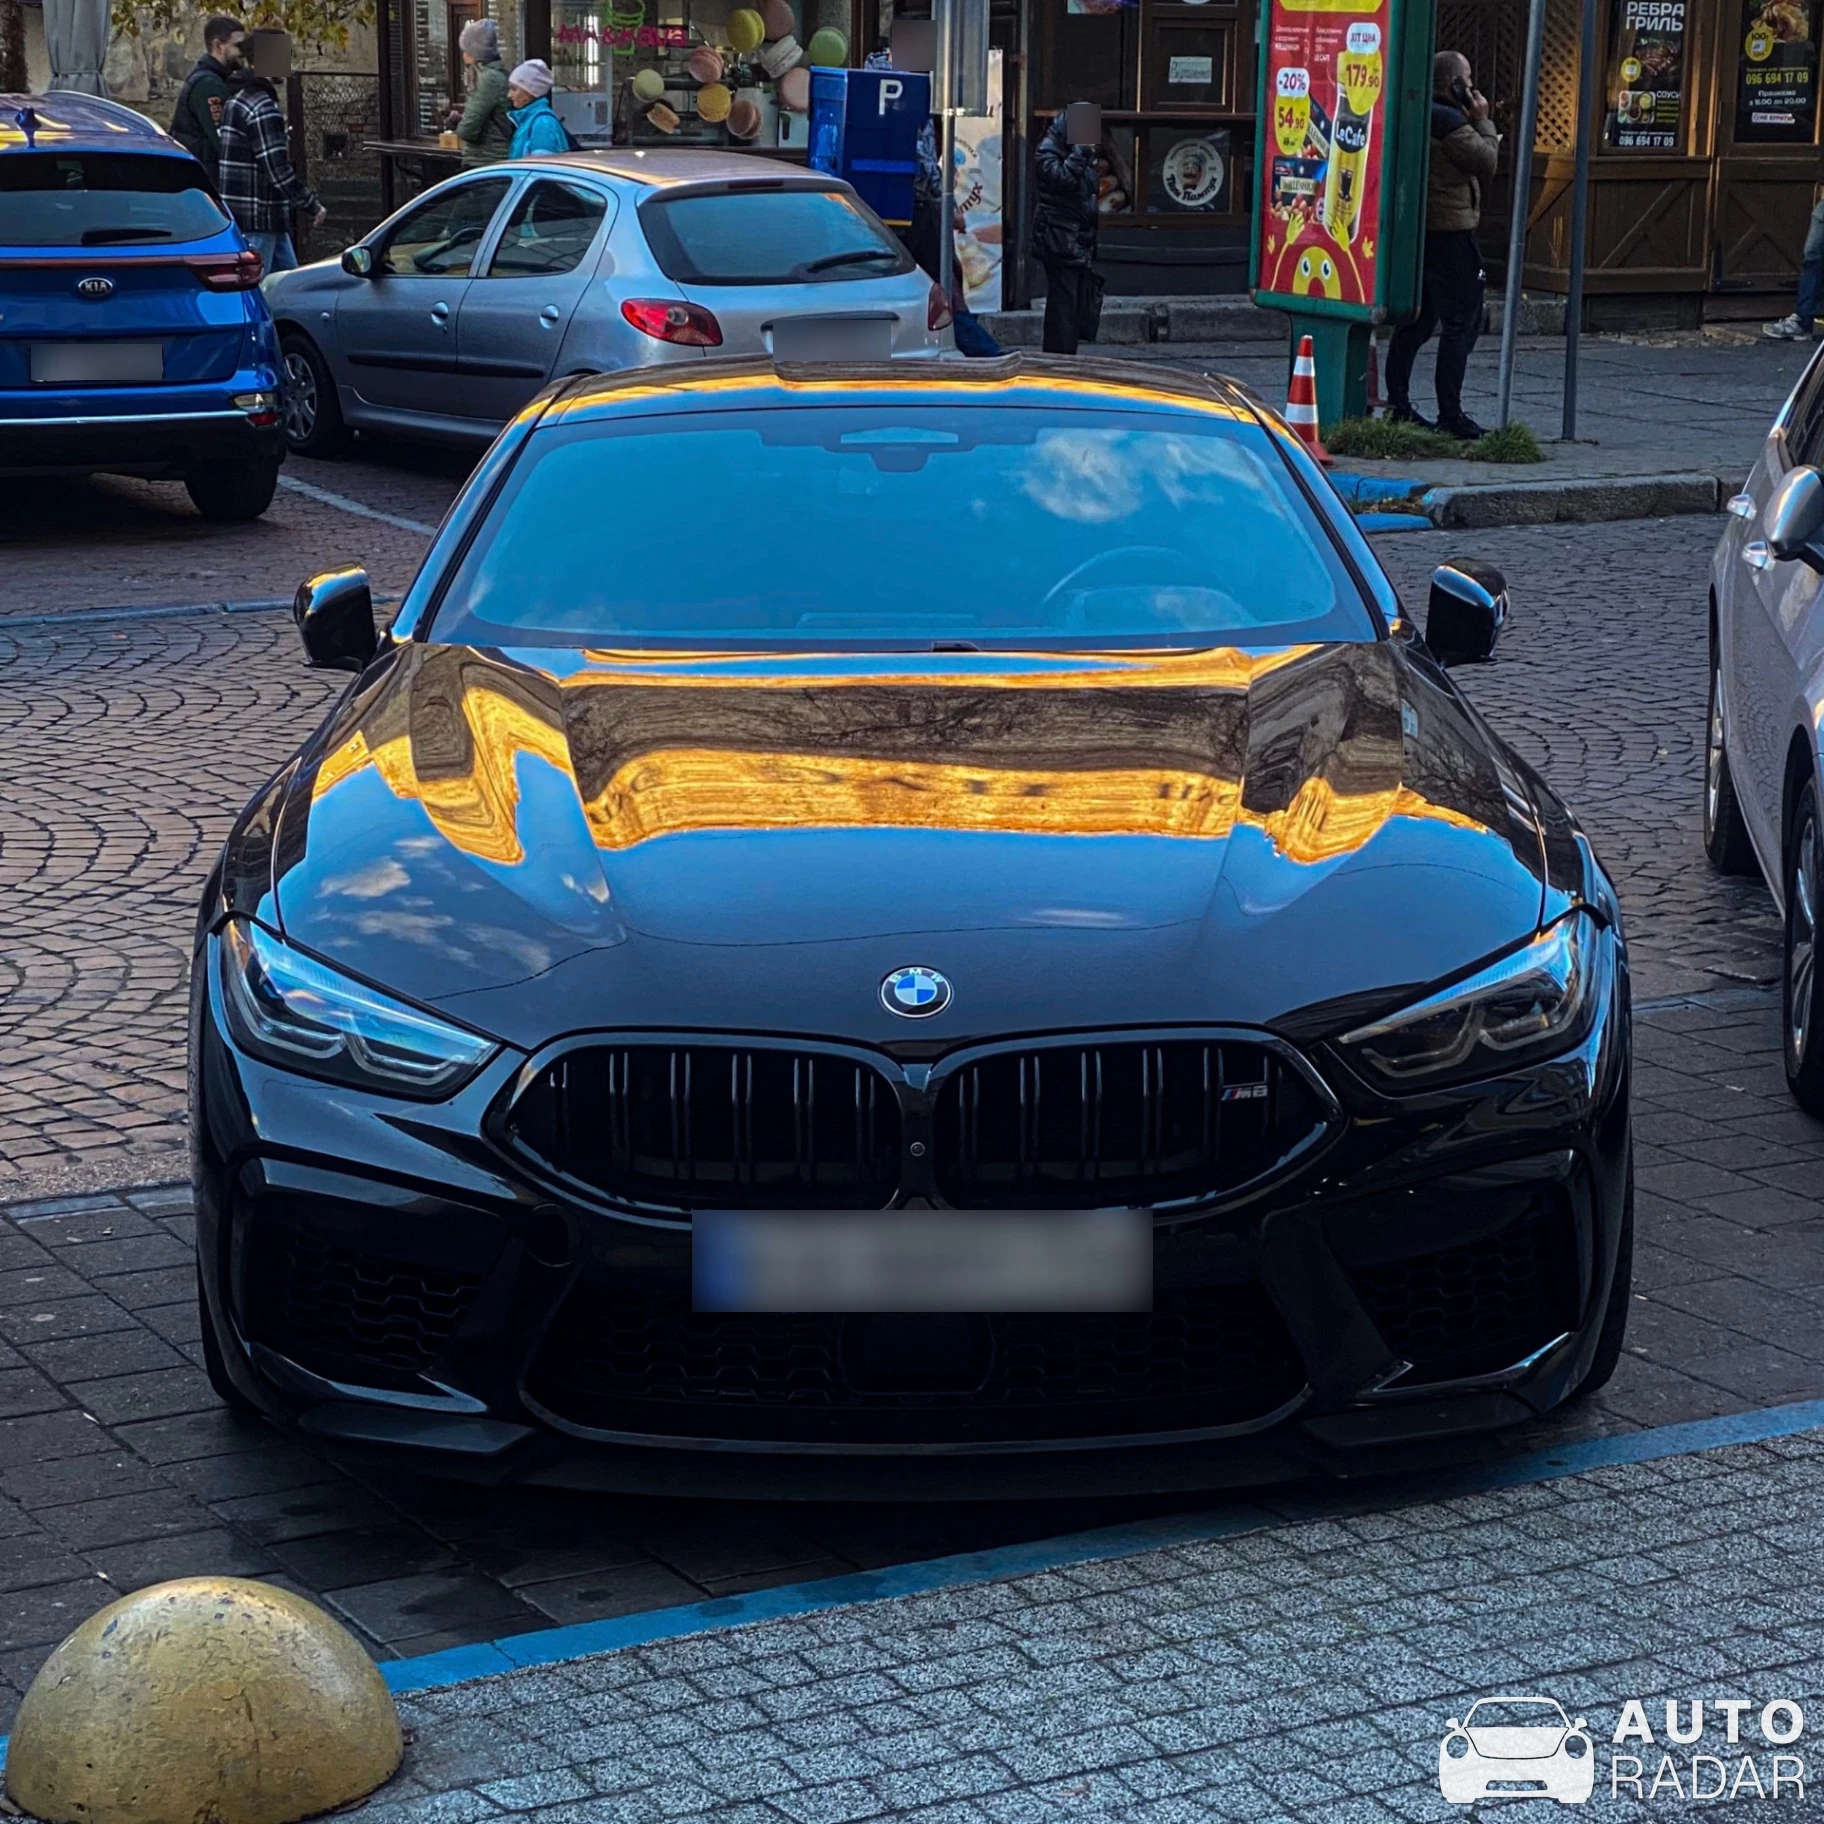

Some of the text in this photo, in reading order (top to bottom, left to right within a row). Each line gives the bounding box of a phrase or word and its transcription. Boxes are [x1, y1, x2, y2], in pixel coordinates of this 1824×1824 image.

[1627, 1, 1685, 17] РЕБРА
[1626, 16, 1684, 31] ГРИЛЬ
[1279, 72, 1307, 91] -20%
[1745, 72, 1809, 85] 096 694 17 09
[879, 79, 903, 116] P
[1619, 135, 1674, 147] 096 694 17 09
[1166, 173, 1182, 198] Пан
[84, 281, 109, 293] KIA
[888, 967, 945, 984] BMW
[1232, 1085, 1268, 1100] M8
